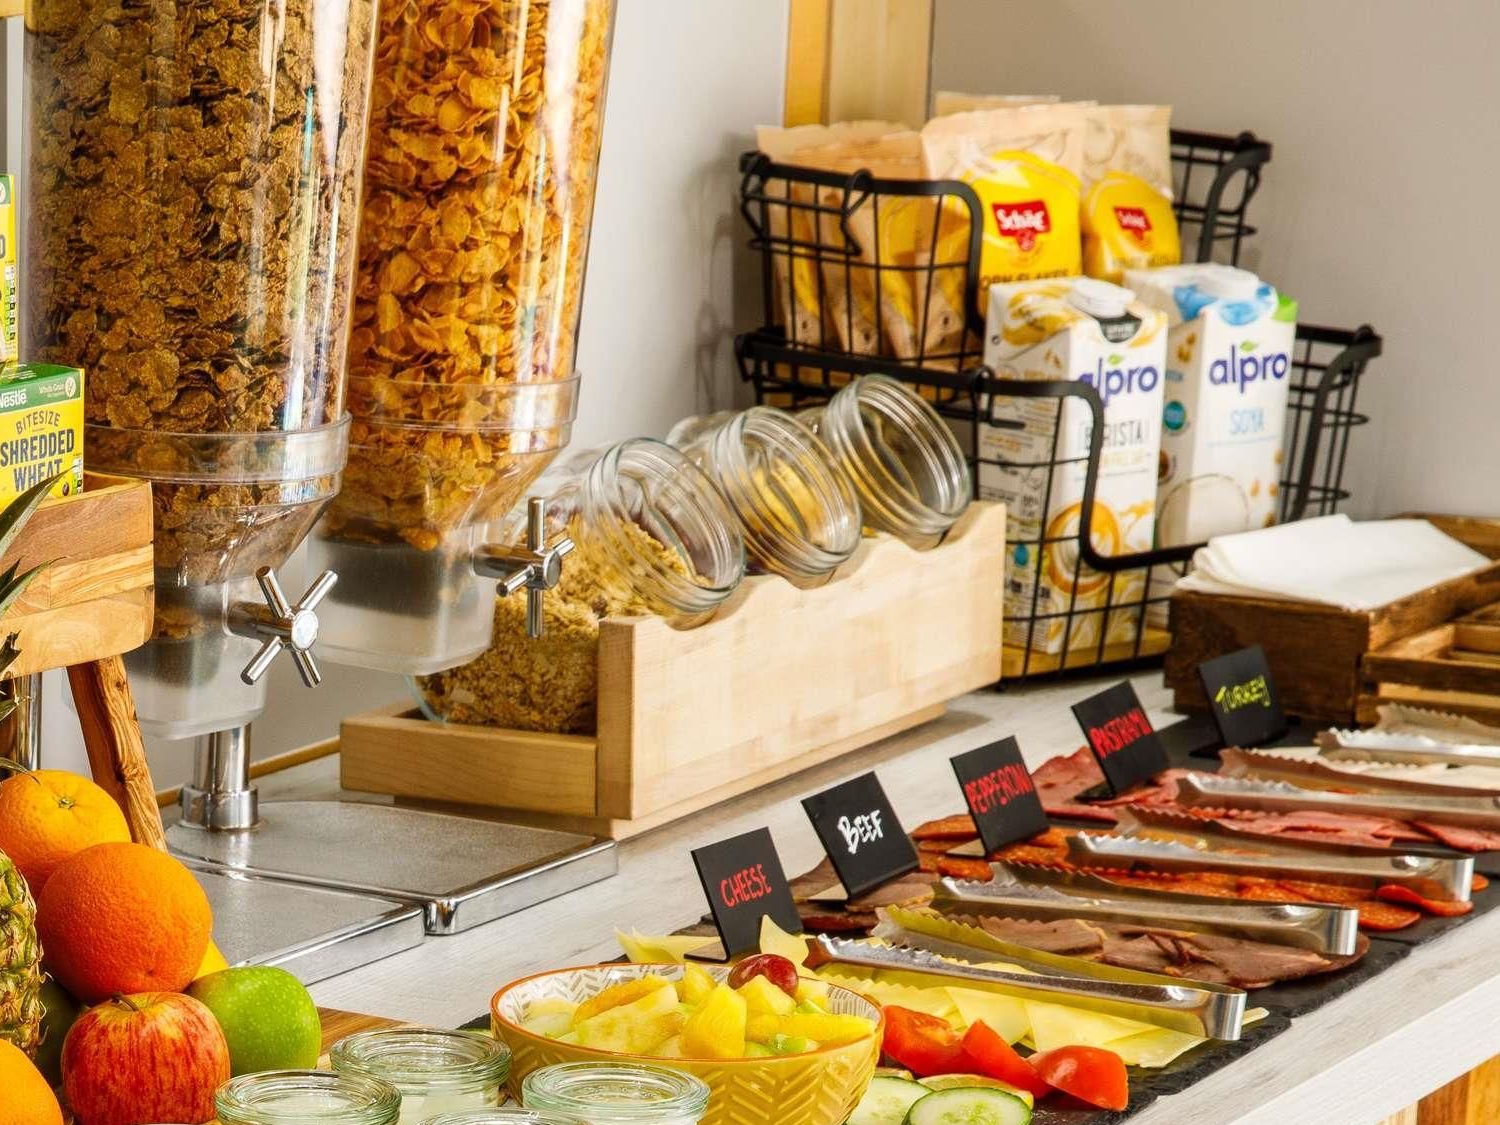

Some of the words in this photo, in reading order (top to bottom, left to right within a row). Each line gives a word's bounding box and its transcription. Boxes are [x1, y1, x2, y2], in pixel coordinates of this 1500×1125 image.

[1209, 344, 1288, 394] alpro
[15, 410, 61, 435] BITESIZE
[1080, 419, 1143, 450] BRISTA
[0, 429, 75, 468] SHREDDED
[13, 458, 63, 492] WHEAT
[1215, 674, 1272, 714] TURKEY
[1090, 705, 1153, 760] PASTRAMI
[964, 762, 1033, 815] PEPPERONI
[837, 807, 885, 855] BEEF
[720, 862, 772, 909] CHEESE
